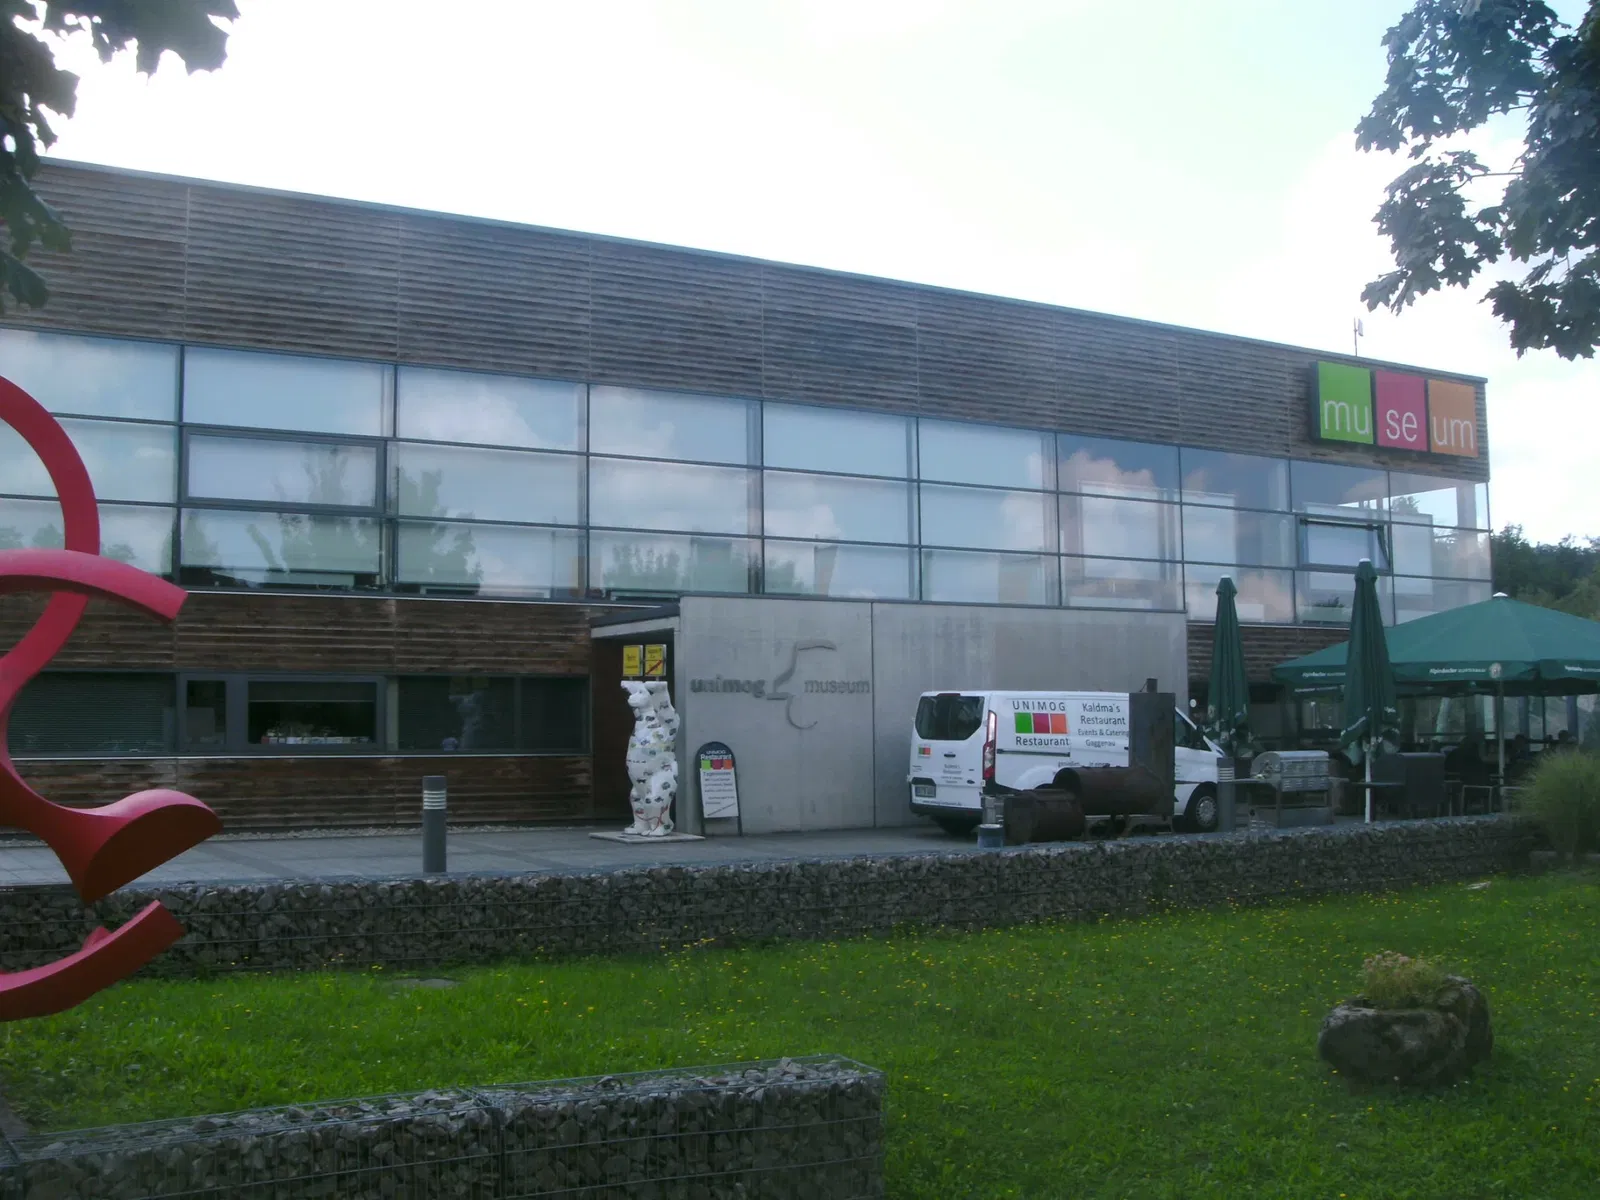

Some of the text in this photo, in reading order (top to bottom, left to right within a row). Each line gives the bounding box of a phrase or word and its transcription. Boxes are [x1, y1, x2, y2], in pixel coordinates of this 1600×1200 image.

[803, 679, 871, 694] museum
[1012, 700, 1066, 711] UNIMOG
[1080, 715, 1126, 725] Restaurant
[1015, 736, 1070, 746] Restaurant
[1085, 739, 1116, 748] Gaggenau
